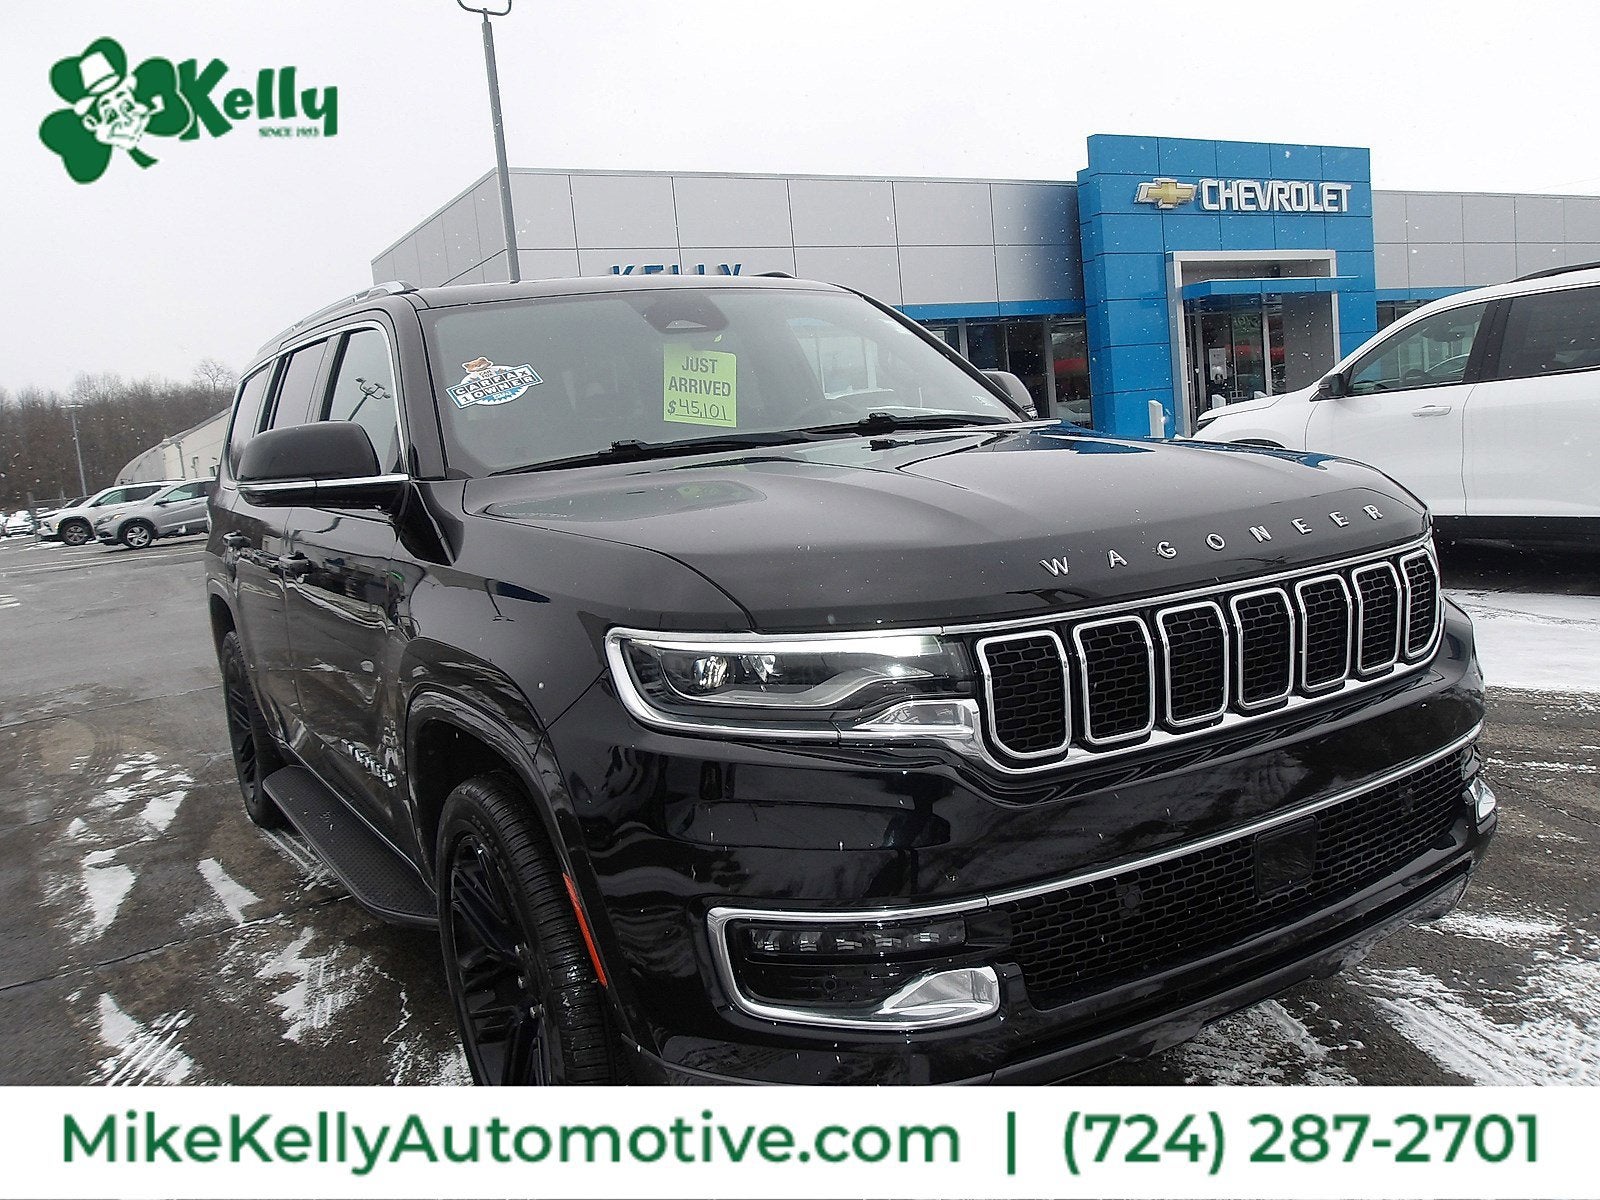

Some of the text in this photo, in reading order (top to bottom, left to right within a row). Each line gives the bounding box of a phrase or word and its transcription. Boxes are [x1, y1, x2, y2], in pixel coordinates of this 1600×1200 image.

[1199, 179, 1352, 212] CHEVROLET
[682, 356, 718, 373] JUST
[453, 370, 529, 396] CARFAX
[472, 375, 536, 399] OWNER
[668, 376, 731, 397] ARRIVED
[667, 398, 727, 420] $45,101
[1039, 504, 1384, 577] WAGONEER
